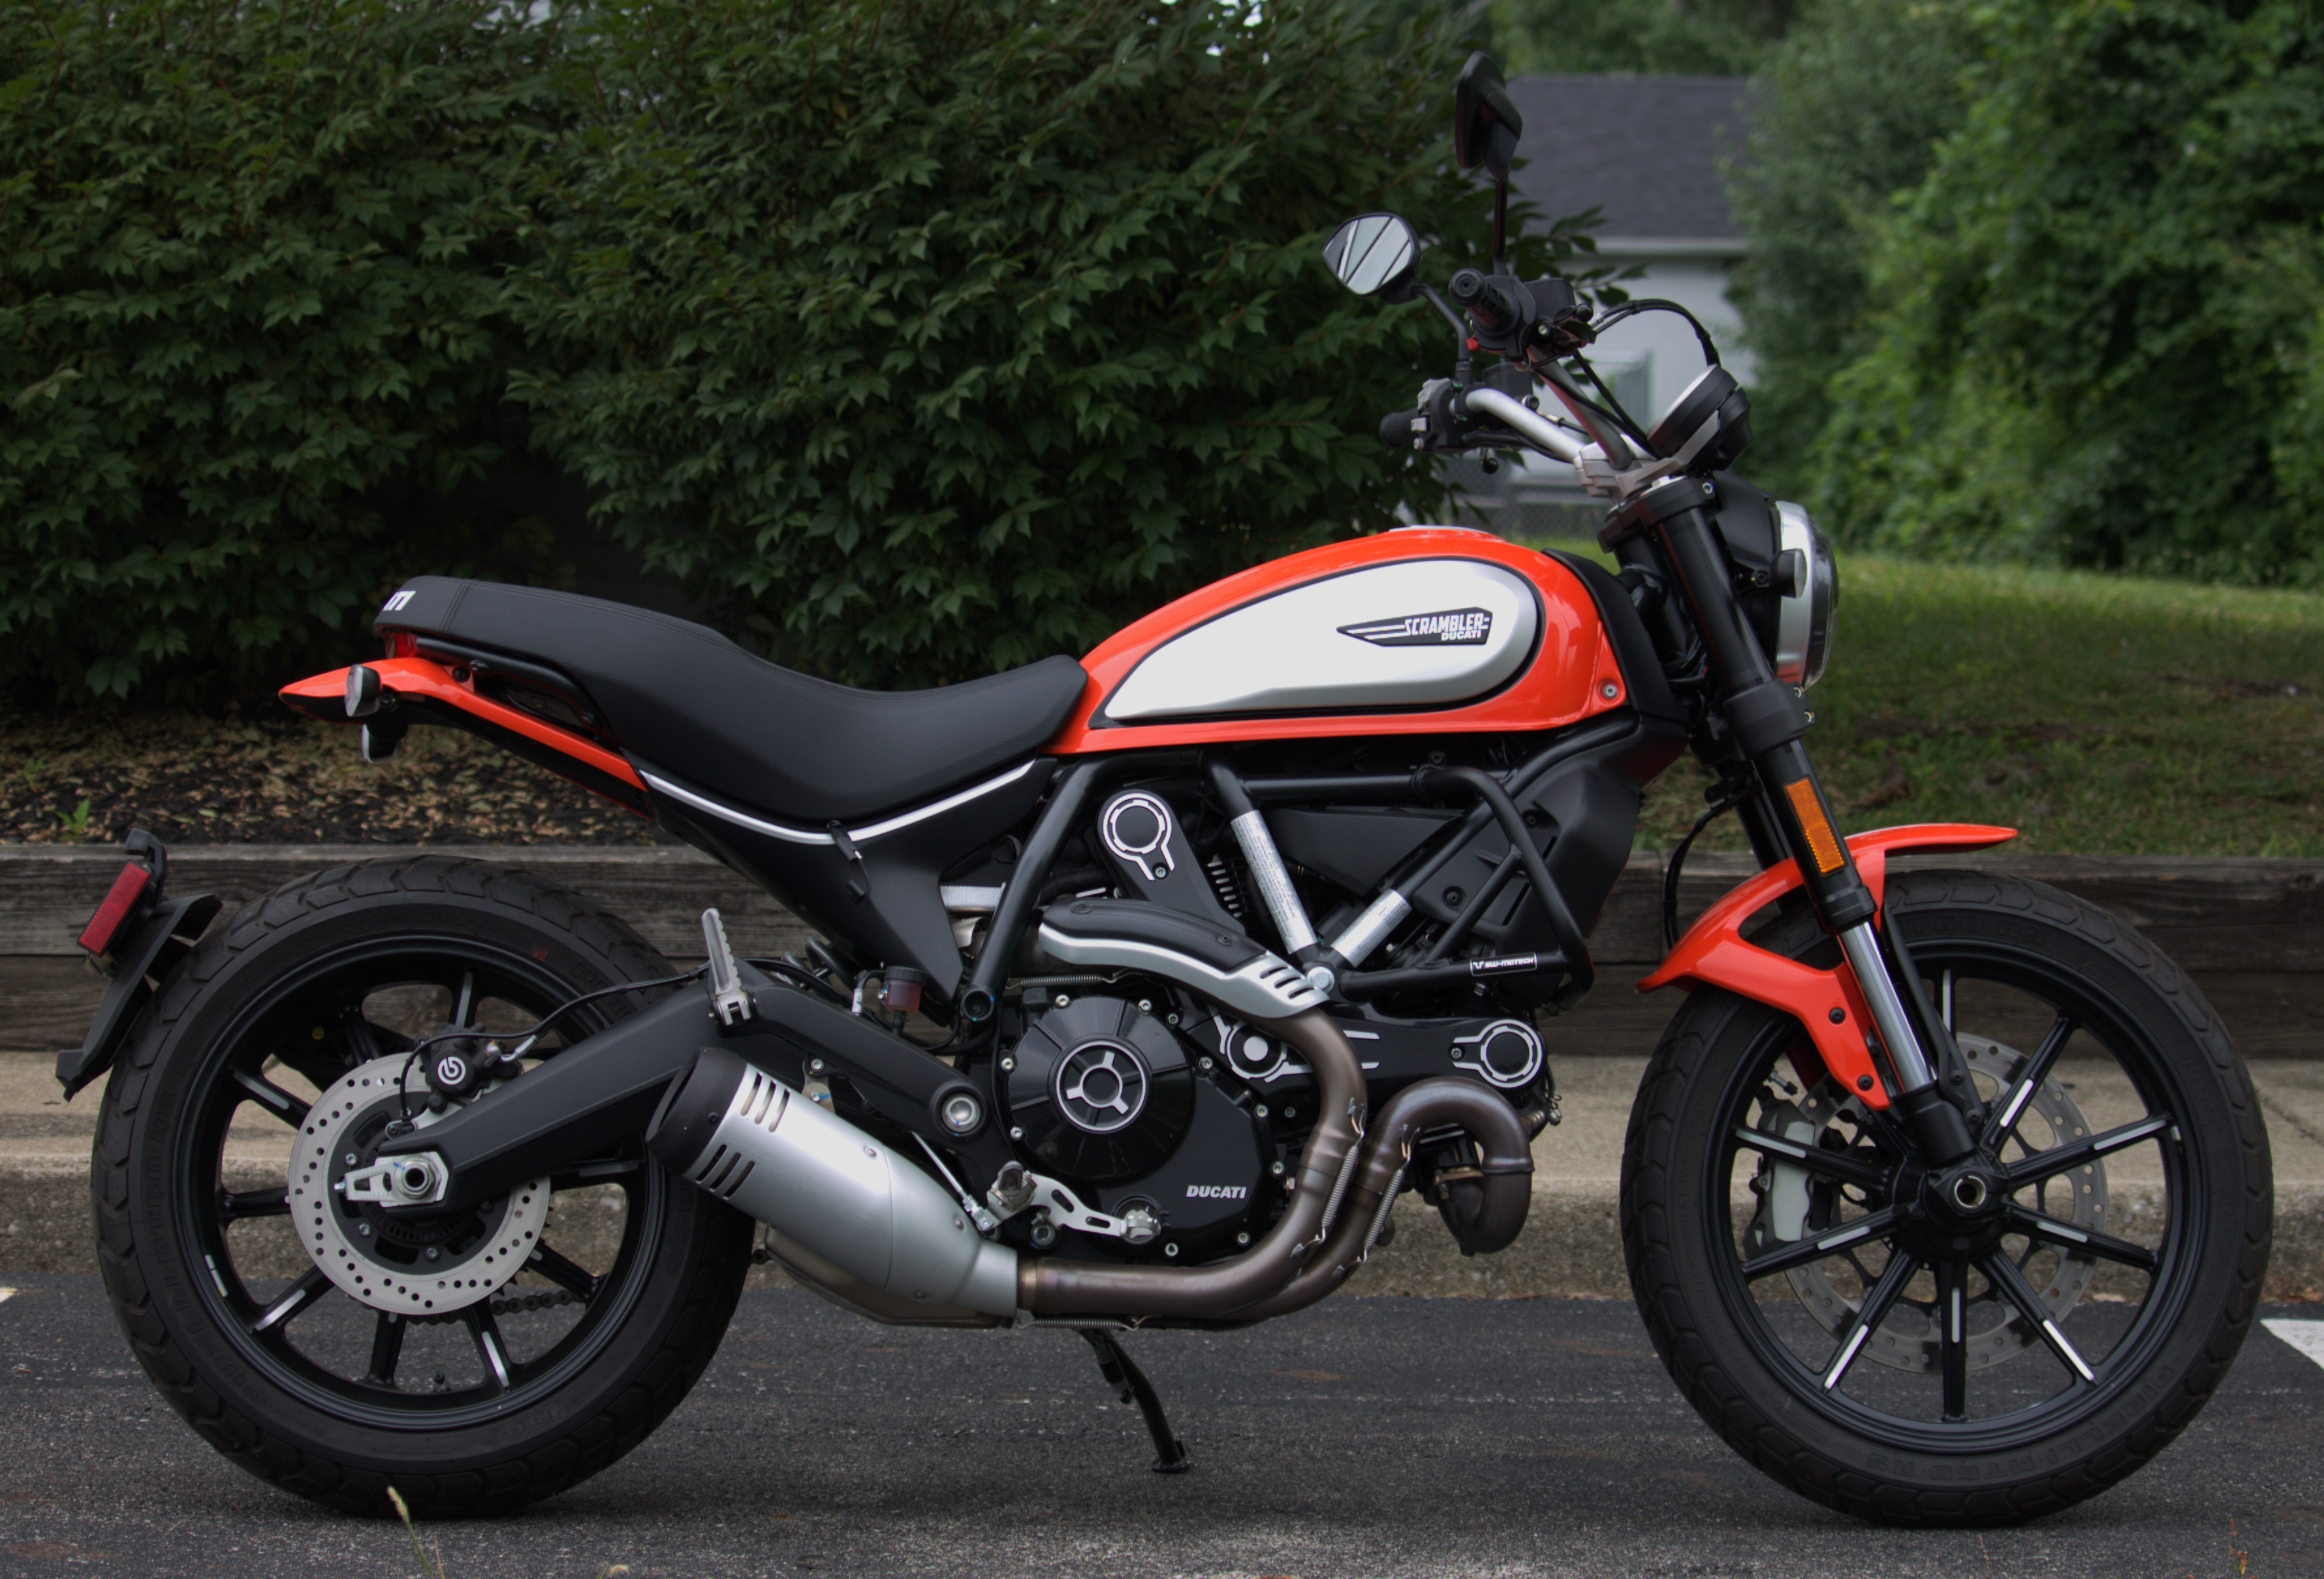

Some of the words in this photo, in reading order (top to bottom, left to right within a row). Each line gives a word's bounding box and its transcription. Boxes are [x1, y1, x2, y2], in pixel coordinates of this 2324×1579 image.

[1404, 613, 1484, 636] SCRAMBLER
[1441, 630, 1482, 641] DUCATI
[1186, 1185, 1247, 1199] DUCATI
[161, 1273, 267, 1405] PIRELLI
[2045, 1365, 2176, 1463] PIRELLI
[1930, 1455, 2036, 1480] MT60
